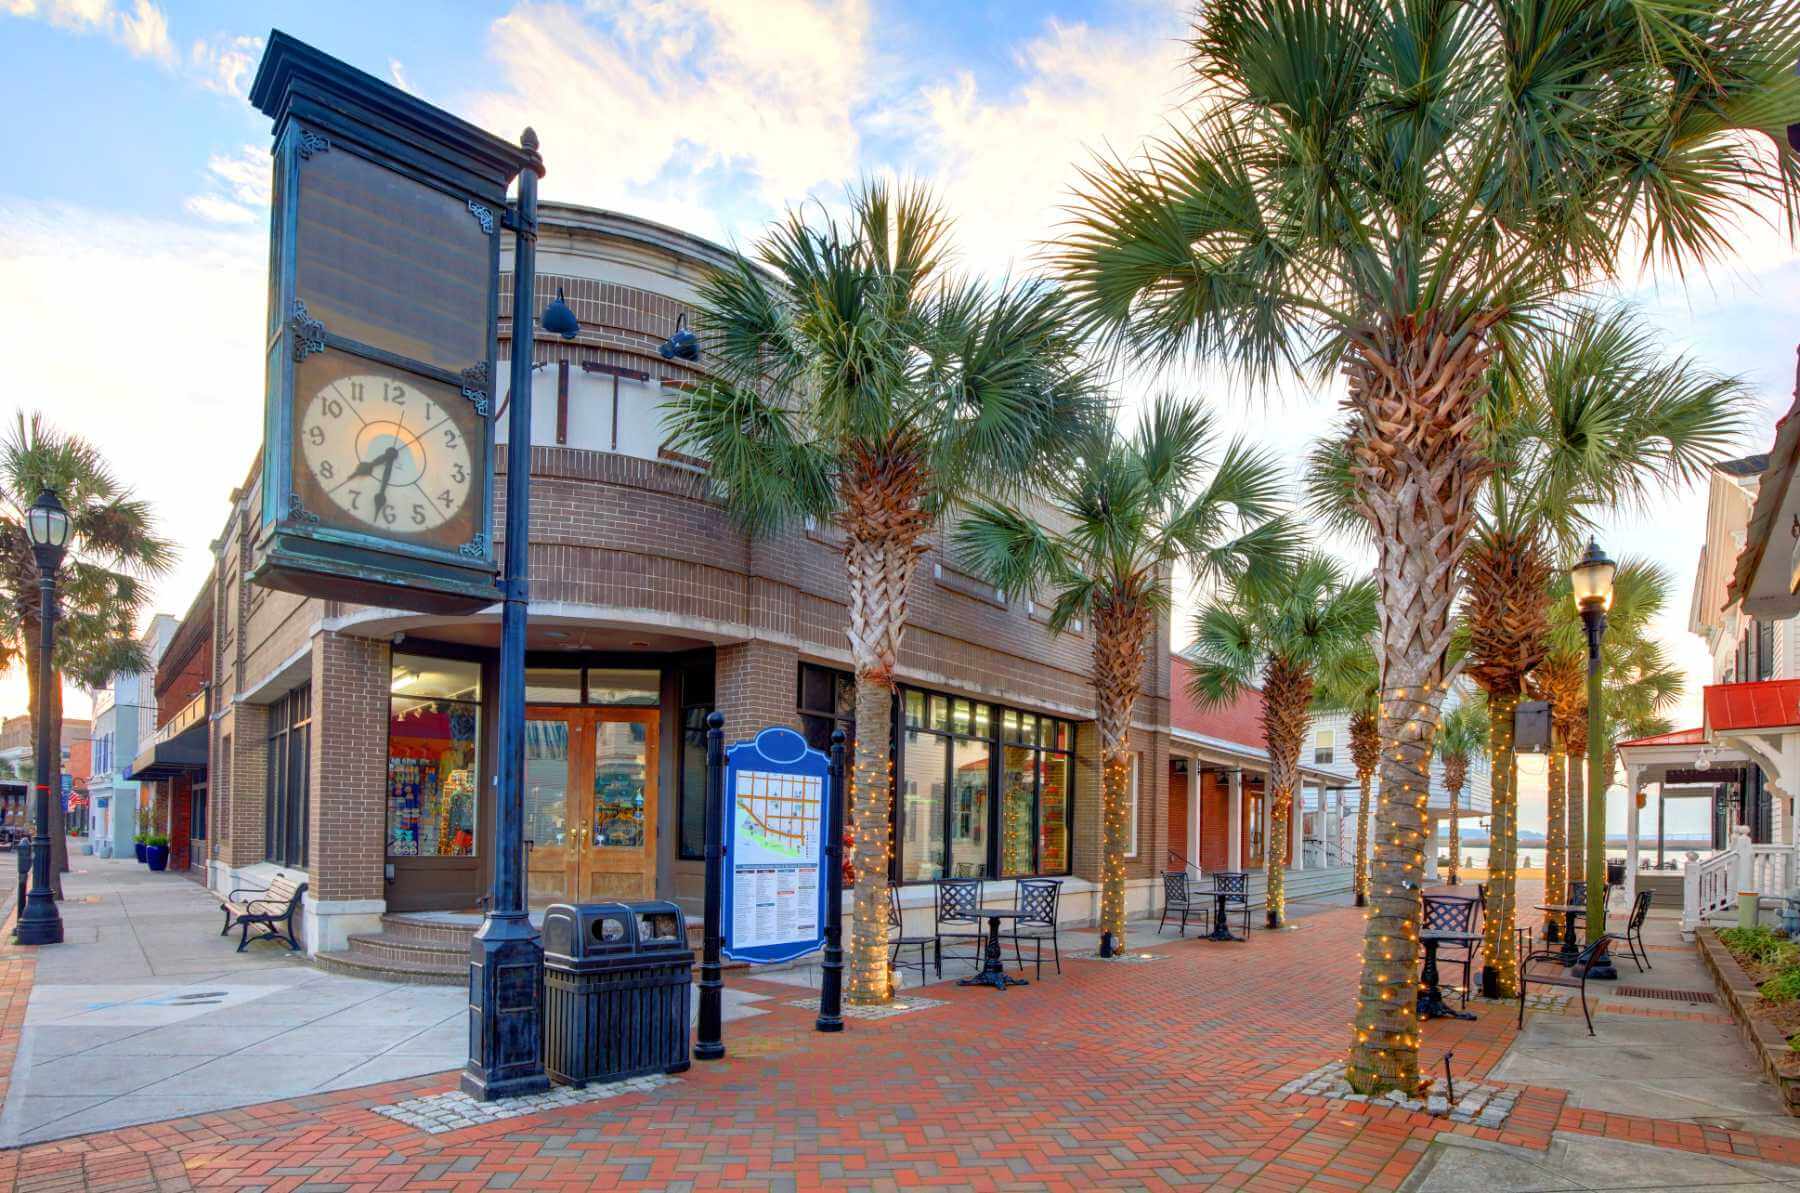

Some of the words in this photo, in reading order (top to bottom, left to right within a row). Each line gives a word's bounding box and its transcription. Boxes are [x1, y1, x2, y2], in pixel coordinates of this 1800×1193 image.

[351, 382, 364, 402] 11
[383, 382, 406, 405] 12
[321, 397, 343, 418] 10
[425, 402, 431, 421] 1
[309, 425, 325, 446] 9
[444, 430, 458, 449] 2
[319, 460, 333, 480] 8
[451, 463, 465, 484] 3
[348, 489, 361, 510] 7
[437, 489, 454, 509] 4
[382, 504, 396, 524] 6
[411, 504, 426, 525] 5
